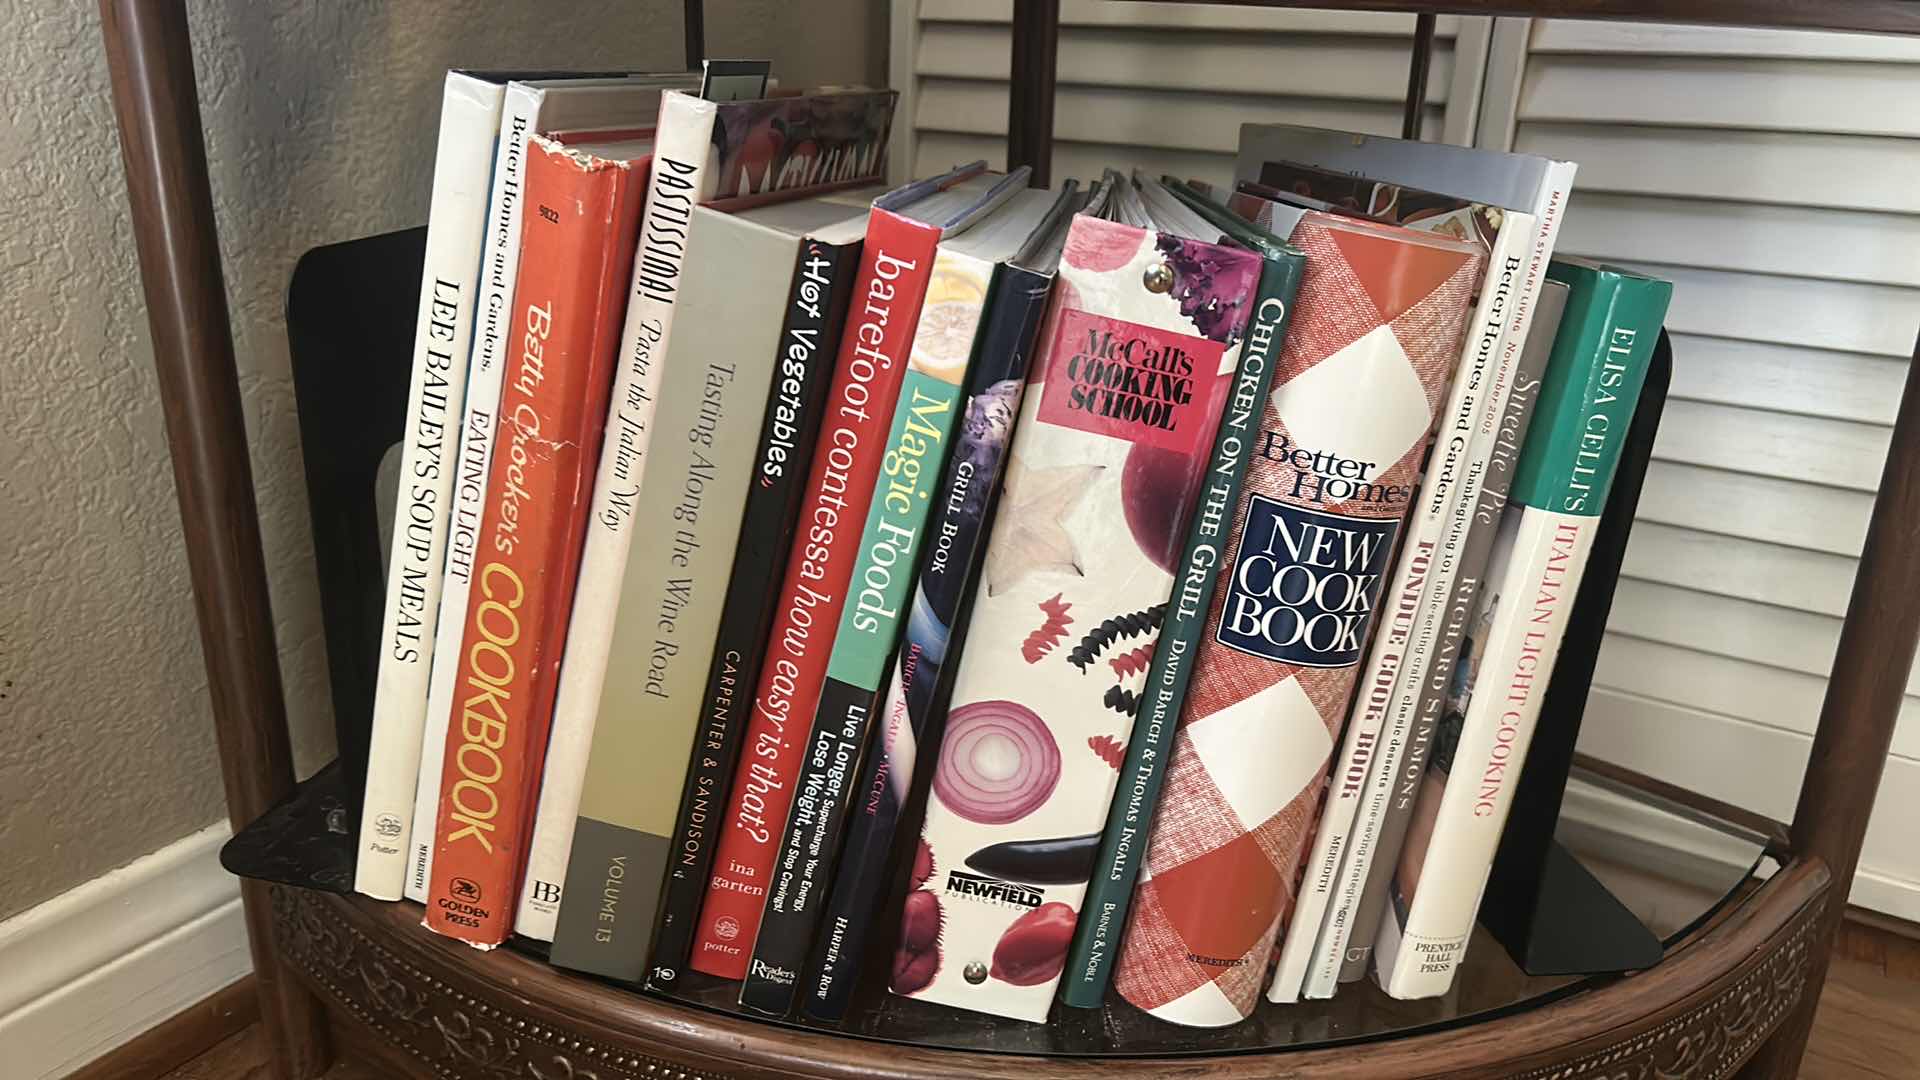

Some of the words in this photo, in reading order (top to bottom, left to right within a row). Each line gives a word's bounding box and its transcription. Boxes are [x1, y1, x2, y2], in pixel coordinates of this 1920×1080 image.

[505, 115, 526, 174] Better
[498, 175, 518, 249] Homes
[1539, 191, 1560, 239] MARTHA
[492, 254, 507, 289] and
[1496, 255, 1520, 308] Better
[1524, 241, 1545, 292] STEWART
[430, 276, 460, 342] LEE
[839, 249, 916, 423] barefoot
[1513, 294, 1530, 332] LIVING
[513, 301, 552, 395] Betty
[631, 318, 662, 377] Pasta
[1083, 328, 1194, 375] McCall's
[1229, 297, 1285, 431] CHICKEN
[1469, 318, 1501, 390] Homes
[1492, 341, 1517, 405] November
[1594, 326, 1637, 405] ELISA
[629, 379, 647, 412] the
[689, 362, 738, 450] Tasting
[1067, 354, 1193, 406] COOKING
[1067, 383, 1177, 433] SCHOOL
[415, 352, 451, 480] BAILEY'S
[1456, 395, 1475, 434] and
[1481, 405, 1497, 435] 2005
[1490, 370, 1541, 473] Sweetie
[460, 409, 490, 503] EATING
[615, 413, 648, 481] Italian
[883, 387, 950, 515] Magic
[1216, 436, 1242, 477] ON
[1261, 430, 1375, 481] Better
[1563, 412, 1609, 512] CELLI'S
[495, 403, 540, 555] Crocker's
[673, 453, 715, 522] Along
[801, 429, 857, 581] contessa
[947, 461, 974, 515] GRILL
[1288, 470, 1409, 503] Homes
[1445, 460, 1483, 551] Thanksgiving
[1475, 481, 1509, 525] Pie
[407, 485, 437, 562] SOUP
[598, 484, 641, 532] Way
[1199, 484, 1232, 537] THE
[451, 508, 477, 584] LIGHT
[672, 528, 701, 568] the
[931, 521, 959, 575] BOOK
[1262, 514, 1385, 573] NEW
[853, 516, 917, 635] Foods
[1175, 544, 1217, 623] GRILL
[1239, 554, 1379, 613] COOK
[1388, 541, 1436, 646] FONDUE
[1530, 524, 1579, 624] ITALIAN
[393, 567, 427, 664] MEALS
[658, 575, 694, 634] Wine
[782, 584, 831, 659] how
[1227, 592, 1367, 652] BOOK
[1432, 576, 1477, 690] RICHARD
[644, 639, 679, 699] Road
[901, 643, 922, 695] BARICH
[1161, 639, 1187, 687] DAVID
[1365, 653, 1398, 722] COOK
[1508, 631, 1546, 706] LIGHT
[447, 562, 525, 854] COOKBOOK
[707, 650, 740, 758] CARPENTER
[757, 657, 800, 732] easy
[843, 704, 867, 738] Live
[1145, 689, 1175, 745] BARICH
[703, 757, 718, 769] &
[755, 731, 791, 761] is
[812, 730, 837, 768] Lose
[823, 741, 856, 798] Longer,
[1142, 748, 1157, 761] &
[1341, 732, 1375, 800] BOOK
[1397, 698, 1440, 809] SIMMONS
[1474, 711, 1521, 818] COOKING
[736, 759, 784, 844] that?
[797, 772, 827, 825] Weight,
[1125, 761, 1153, 824] THOMAS
[681, 776, 714, 867] SANDISON
[790, 828, 802, 847] and
[809, 799, 836, 857] Supercharge
[728, 860, 755, 877] ina
[783, 846, 799, 868] Stop
[804, 858, 820, 878] Your
[1110, 825, 1138, 881] INGALLS
[1317, 835, 1342, 894] MEREDITH
[438, 898, 490, 919] GOLDEN
[599, 856, 628, 923] VOLUME
[711, 875, 763, 896] garten
[772, 867, 793, 914] Cravings!
[947, 877, 1043, 908] NEWFIELD
[445, 911, 481, 929] PRESS
[703, 941, 741, 955] potter
[828, 915, 849, 962] HARPER
[1092, 940, 1106, 950] &
[1096, 903, 1116, 938] BARNES
[751, 959, 795, 979] Reader's
[823, 963, 833, 972] &
[1420, 962, 1450, 973] PRESS
[1426, 953, 1451, 962] HALL
[817, 973, 833, 1000] ROW
